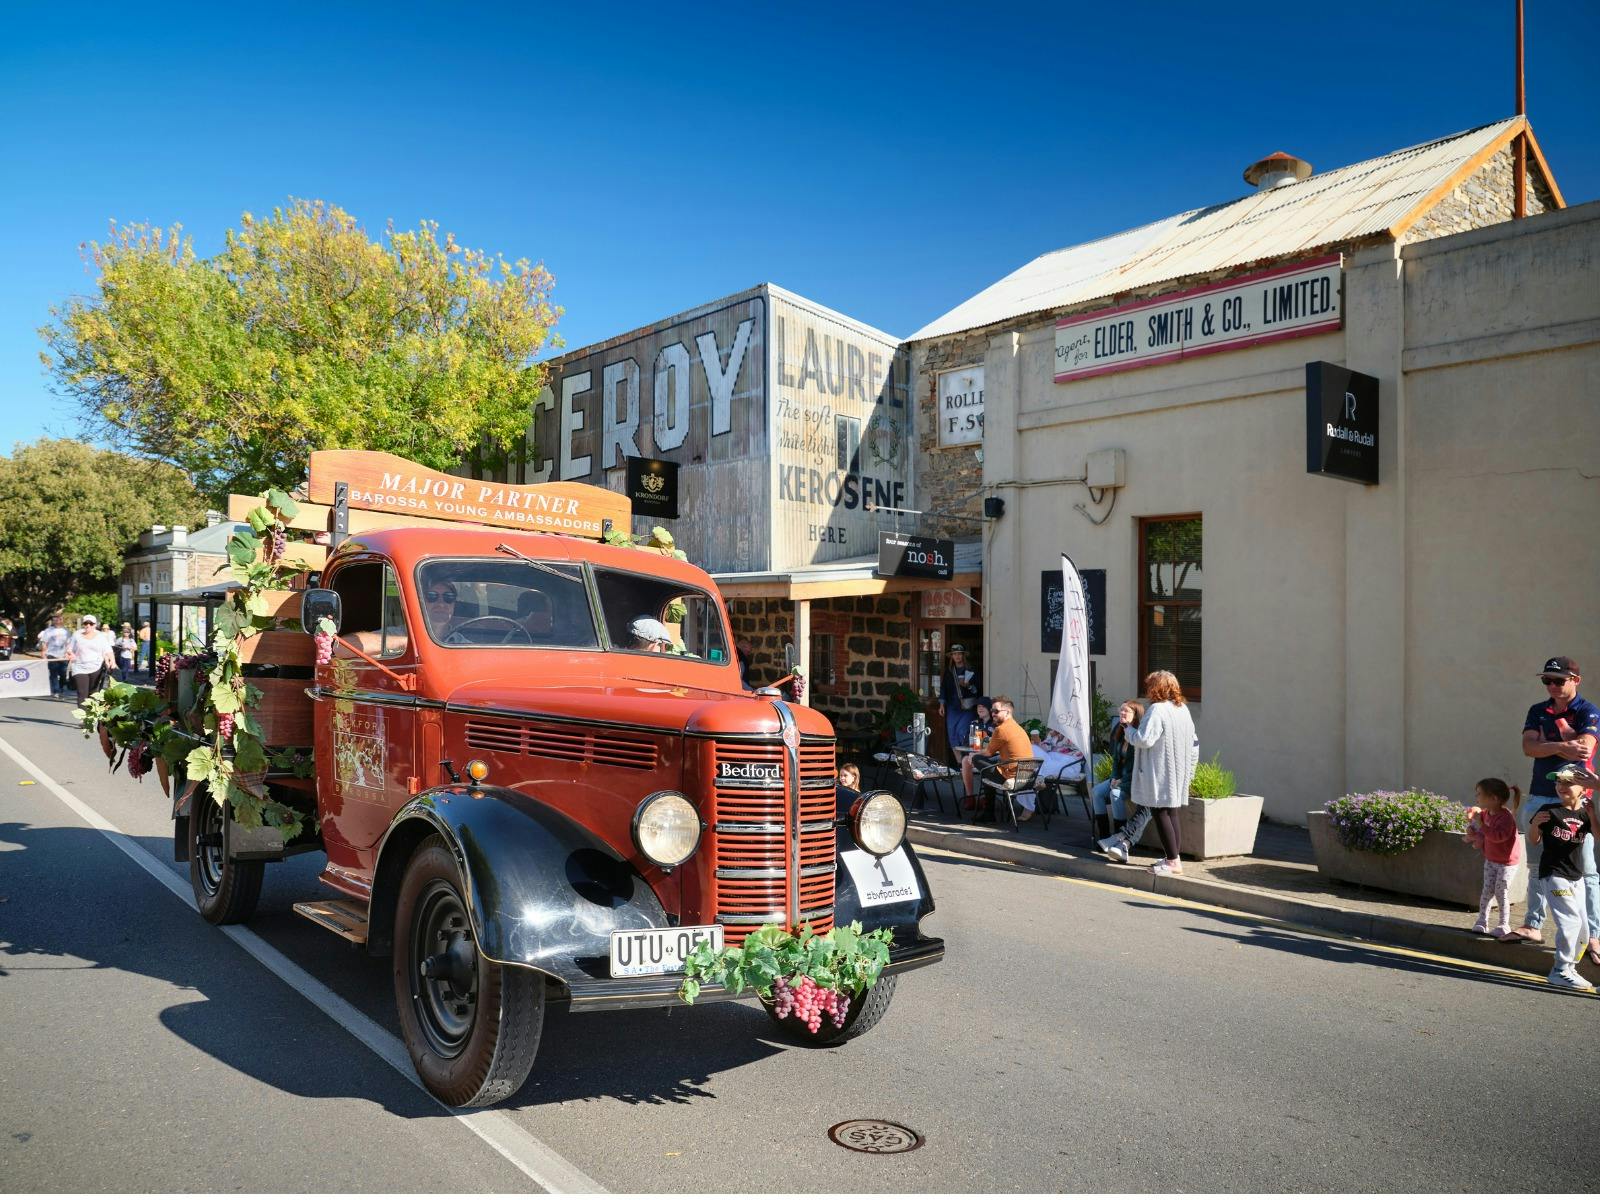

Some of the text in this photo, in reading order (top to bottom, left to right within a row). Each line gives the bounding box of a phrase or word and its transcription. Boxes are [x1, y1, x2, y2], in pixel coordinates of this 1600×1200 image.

[1094, 276, 1336, 359] ELDER, SMITH & CO., LIMITED.
[776, 397, 831, 436] The soft
[1326, 422, 1349, 440] Rudall
[1354, 430, 1374, 447] Rudall
[379, 472, 580, 516] MAJOR PARTNER
[779, 463, 904, 517] KEROSENE
[351, 490, 601, 533] BAROSSA YOUNG AMBASSADORS
[907, 550, 948, 567] nosh.
[721, 763, 781, 778] Bedford
[873, 857, 894, 887] 1
